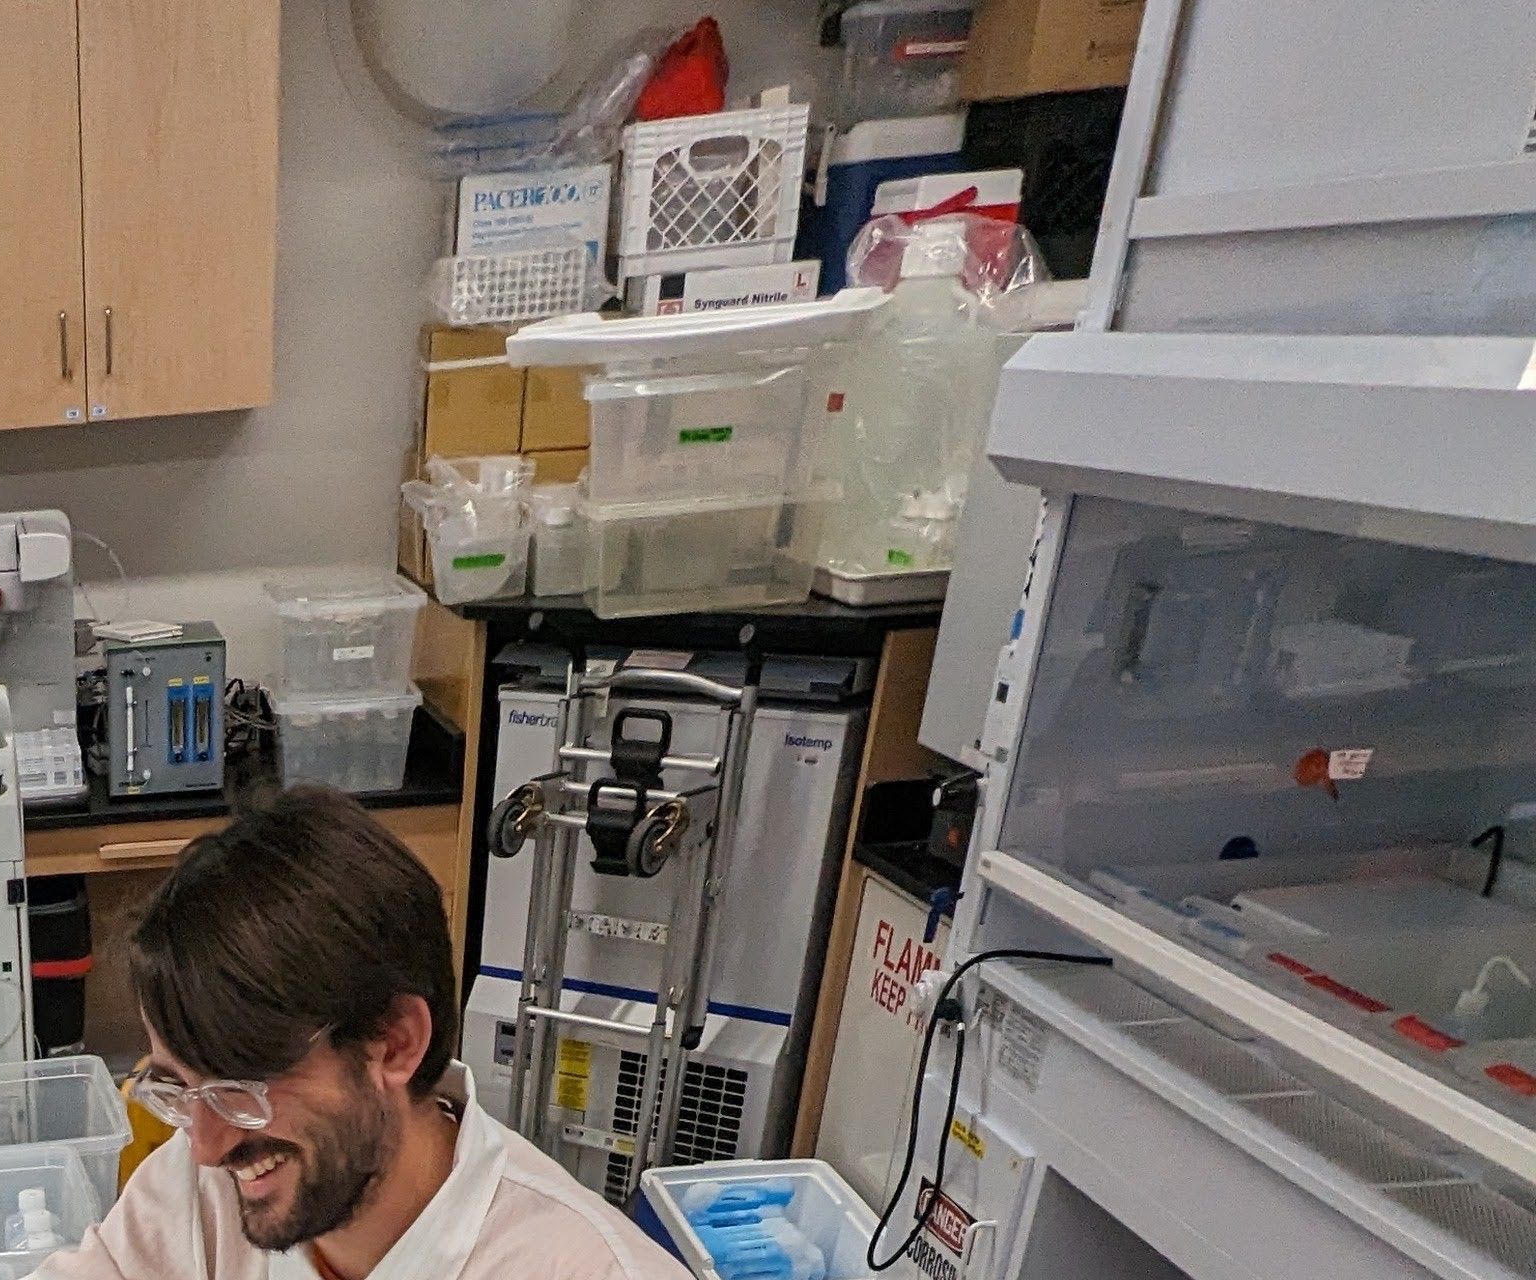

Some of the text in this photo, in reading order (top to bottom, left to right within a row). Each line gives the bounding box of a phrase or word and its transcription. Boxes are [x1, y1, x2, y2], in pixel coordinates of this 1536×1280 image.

[694, 292, 789, 311] Synguard Nitrile
[785, 733, 833, 752] Isotemp
[871, 968, 906, 1015] KEEP
